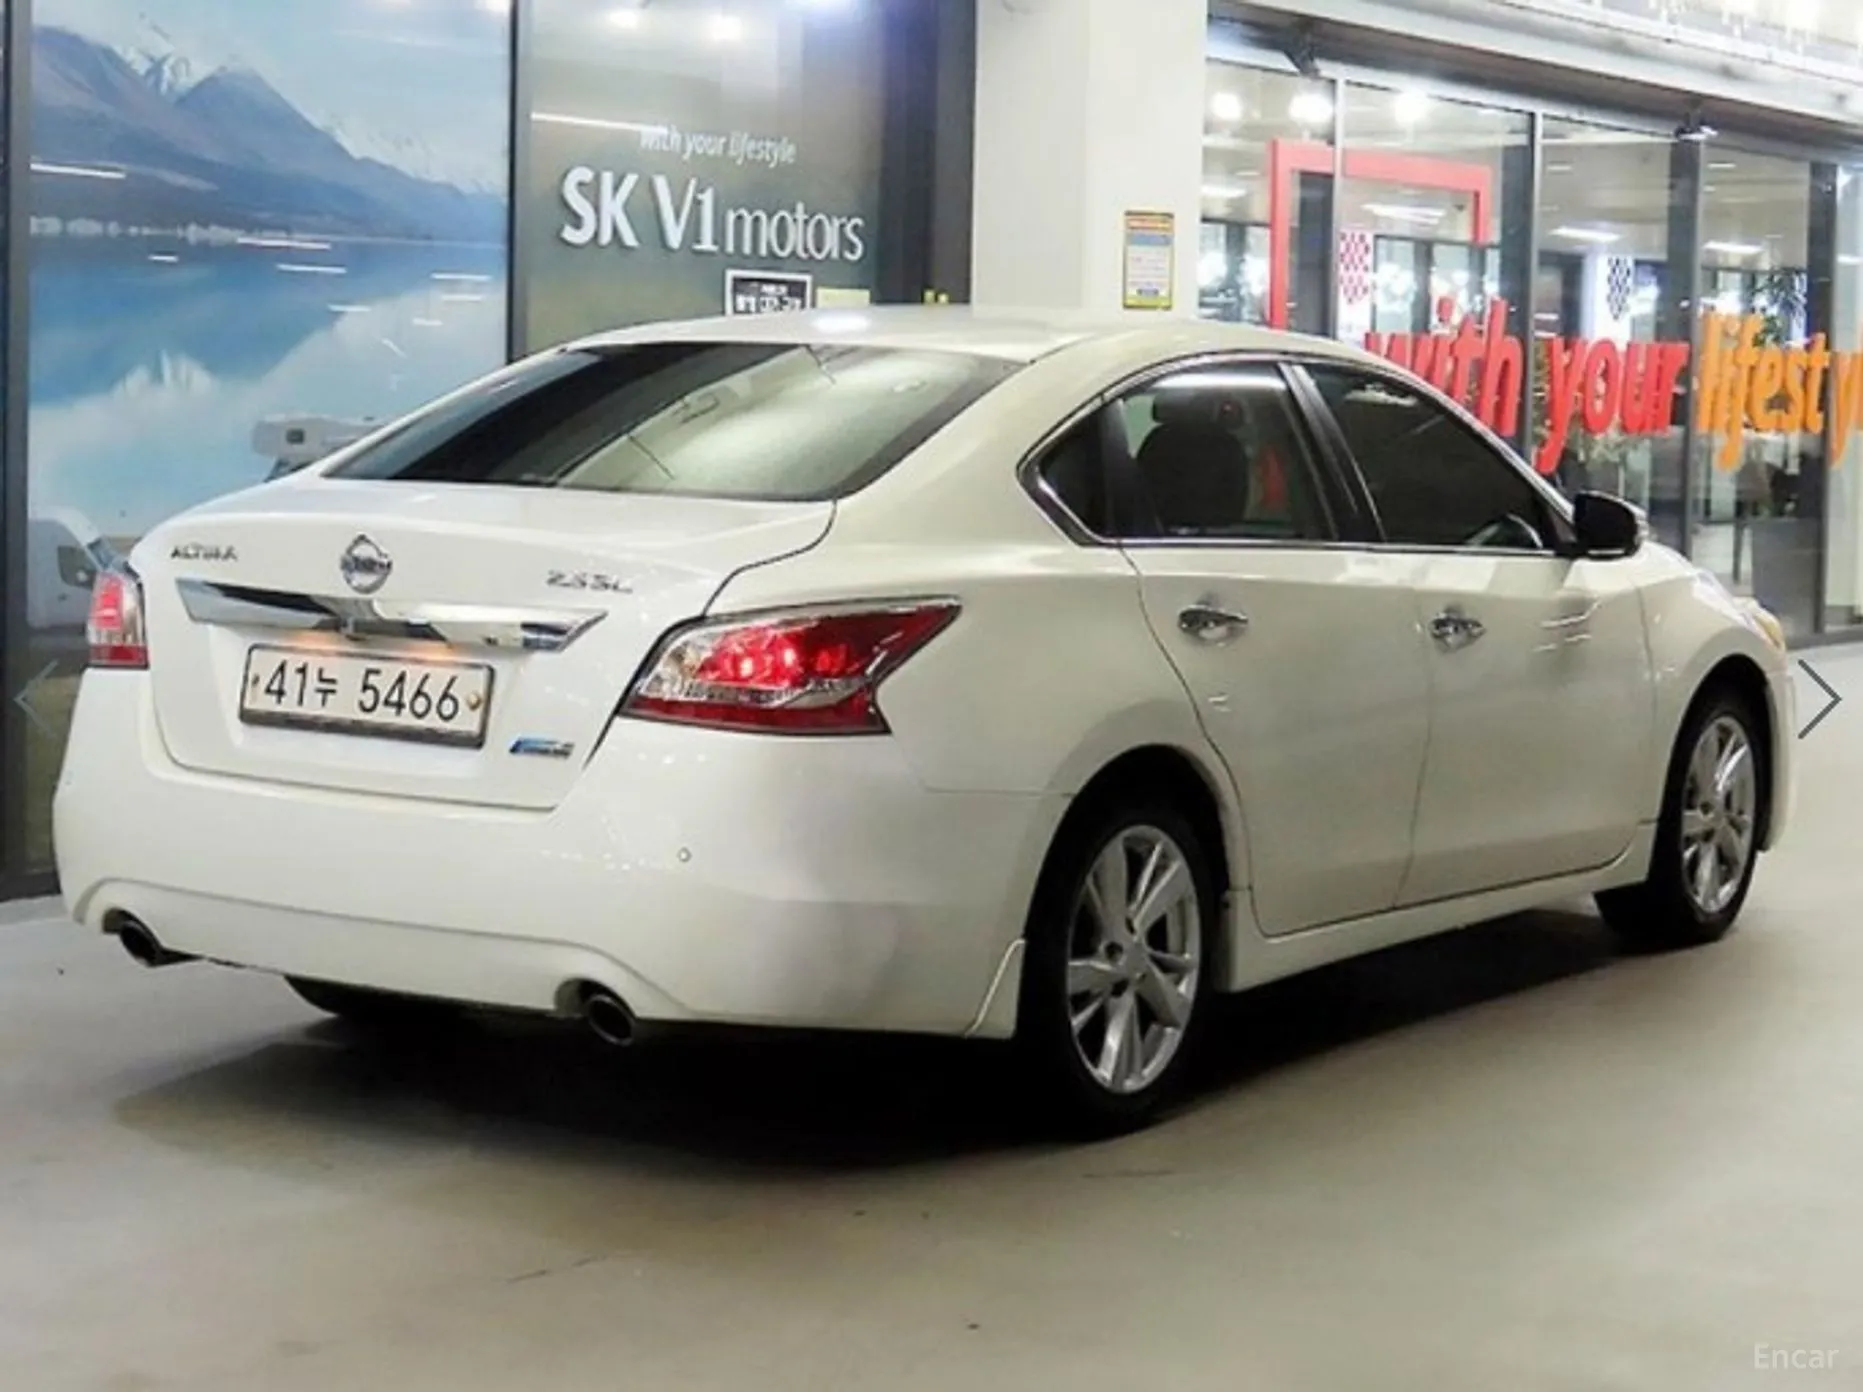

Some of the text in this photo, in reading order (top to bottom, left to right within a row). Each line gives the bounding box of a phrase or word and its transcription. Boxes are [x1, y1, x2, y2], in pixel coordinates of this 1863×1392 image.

[682, 132, 727, 161] your
[728, 131, 797, 169] lifestyle
[560, 166, 640, 247] SK
[1534, 336, 1691, 475] your
[264, 659, 460, 722] 41누 5466
